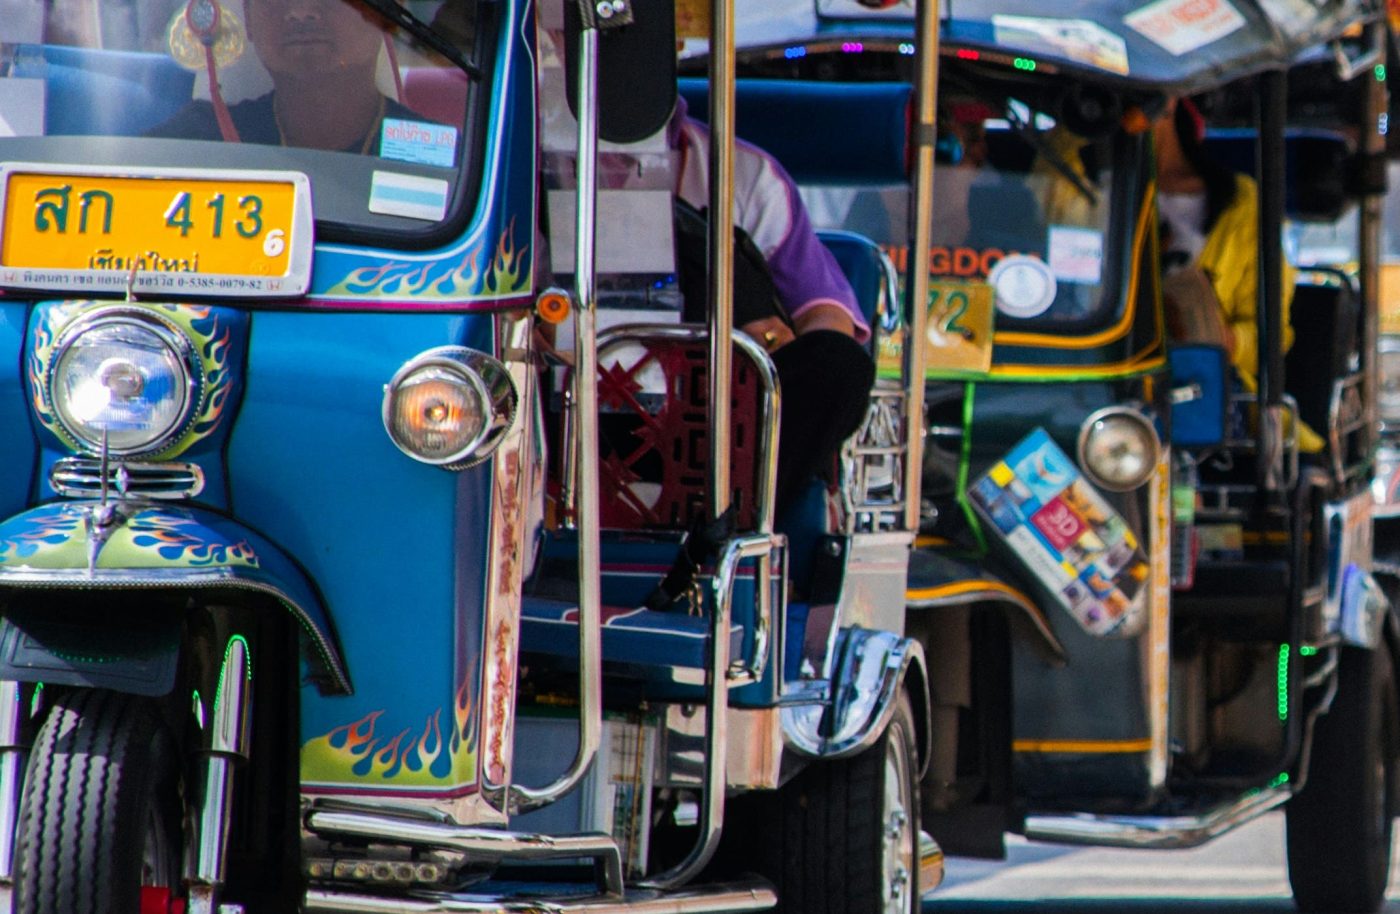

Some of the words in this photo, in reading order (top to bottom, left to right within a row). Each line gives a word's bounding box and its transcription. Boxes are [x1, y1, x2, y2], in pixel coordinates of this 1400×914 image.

[34, 184, 115, 234] สก
[163, 191, 264, 239] 413
[262, 229, 285, 257] 6
[1050, 499, 1080, 537] 3D
